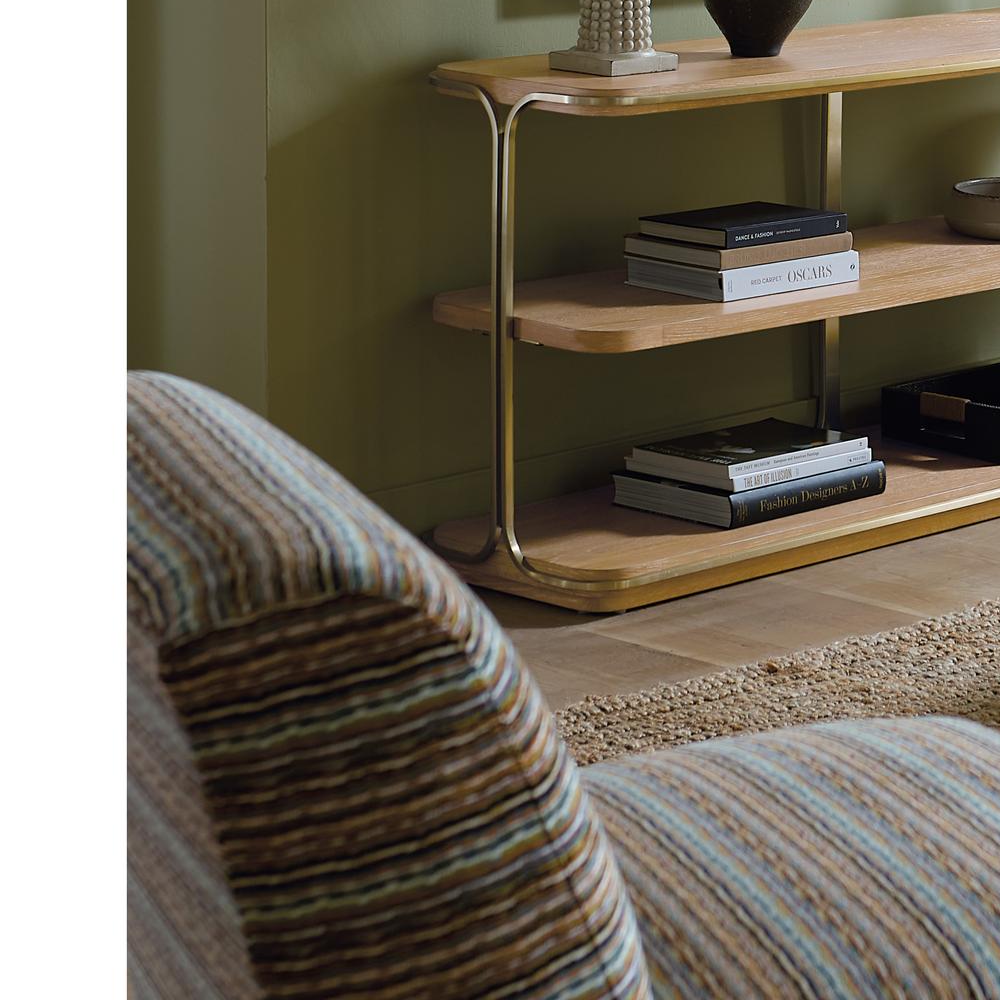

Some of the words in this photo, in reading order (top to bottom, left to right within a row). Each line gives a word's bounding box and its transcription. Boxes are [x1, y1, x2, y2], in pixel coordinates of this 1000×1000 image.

[754, 231, 774, 239] FASHION
[762, 276, 782, 284] CARPET
[788, 264, 832, 282] OSCARS
[744, 476, 753, 488] THE
[754, 474, 762, 486] ART
[764, 472, 770, 484] OF
[770, 468, 792, 483] ILLUSION
[760, 494, 798, 512] Fashion
[801, 484, 848, 502] Designers
[850, 476, 870, 491] A-Z
